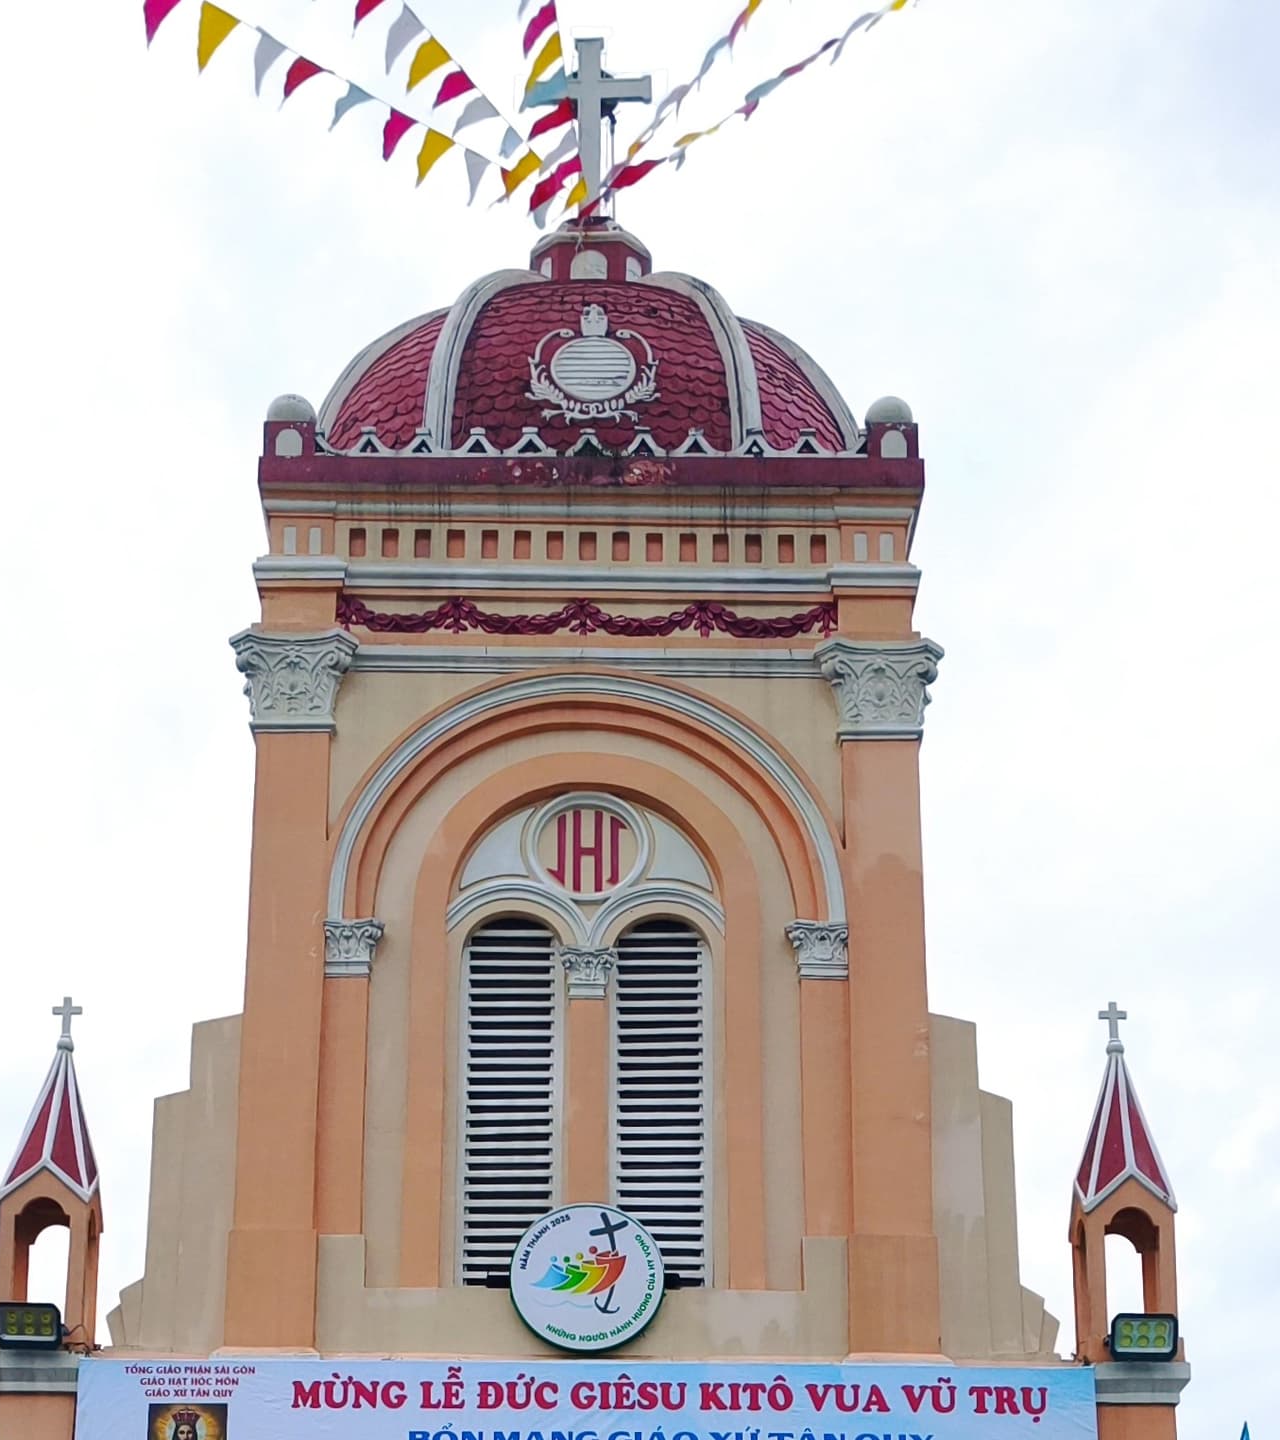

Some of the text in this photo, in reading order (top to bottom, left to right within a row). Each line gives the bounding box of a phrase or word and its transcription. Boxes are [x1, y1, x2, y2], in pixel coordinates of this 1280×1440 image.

[125, 1363, 153, 1374] TỔNG
[156, 1365, 181, 1374] GIÁO
[214, 1365, 230, 1374] SÀI
[233, 1365, 256, 1374] GÒN
[140, 1377, 239, 1388] GIÁO HẠT HÓC MÔN
[145, 1388, 233, 1398] GIÁO XỨ TÂN QUY
[291, 1366, 1048, 1423] MỪNG LỄ ĐỨC GIÊSU KITÔ VUA VŨ TRỤ
